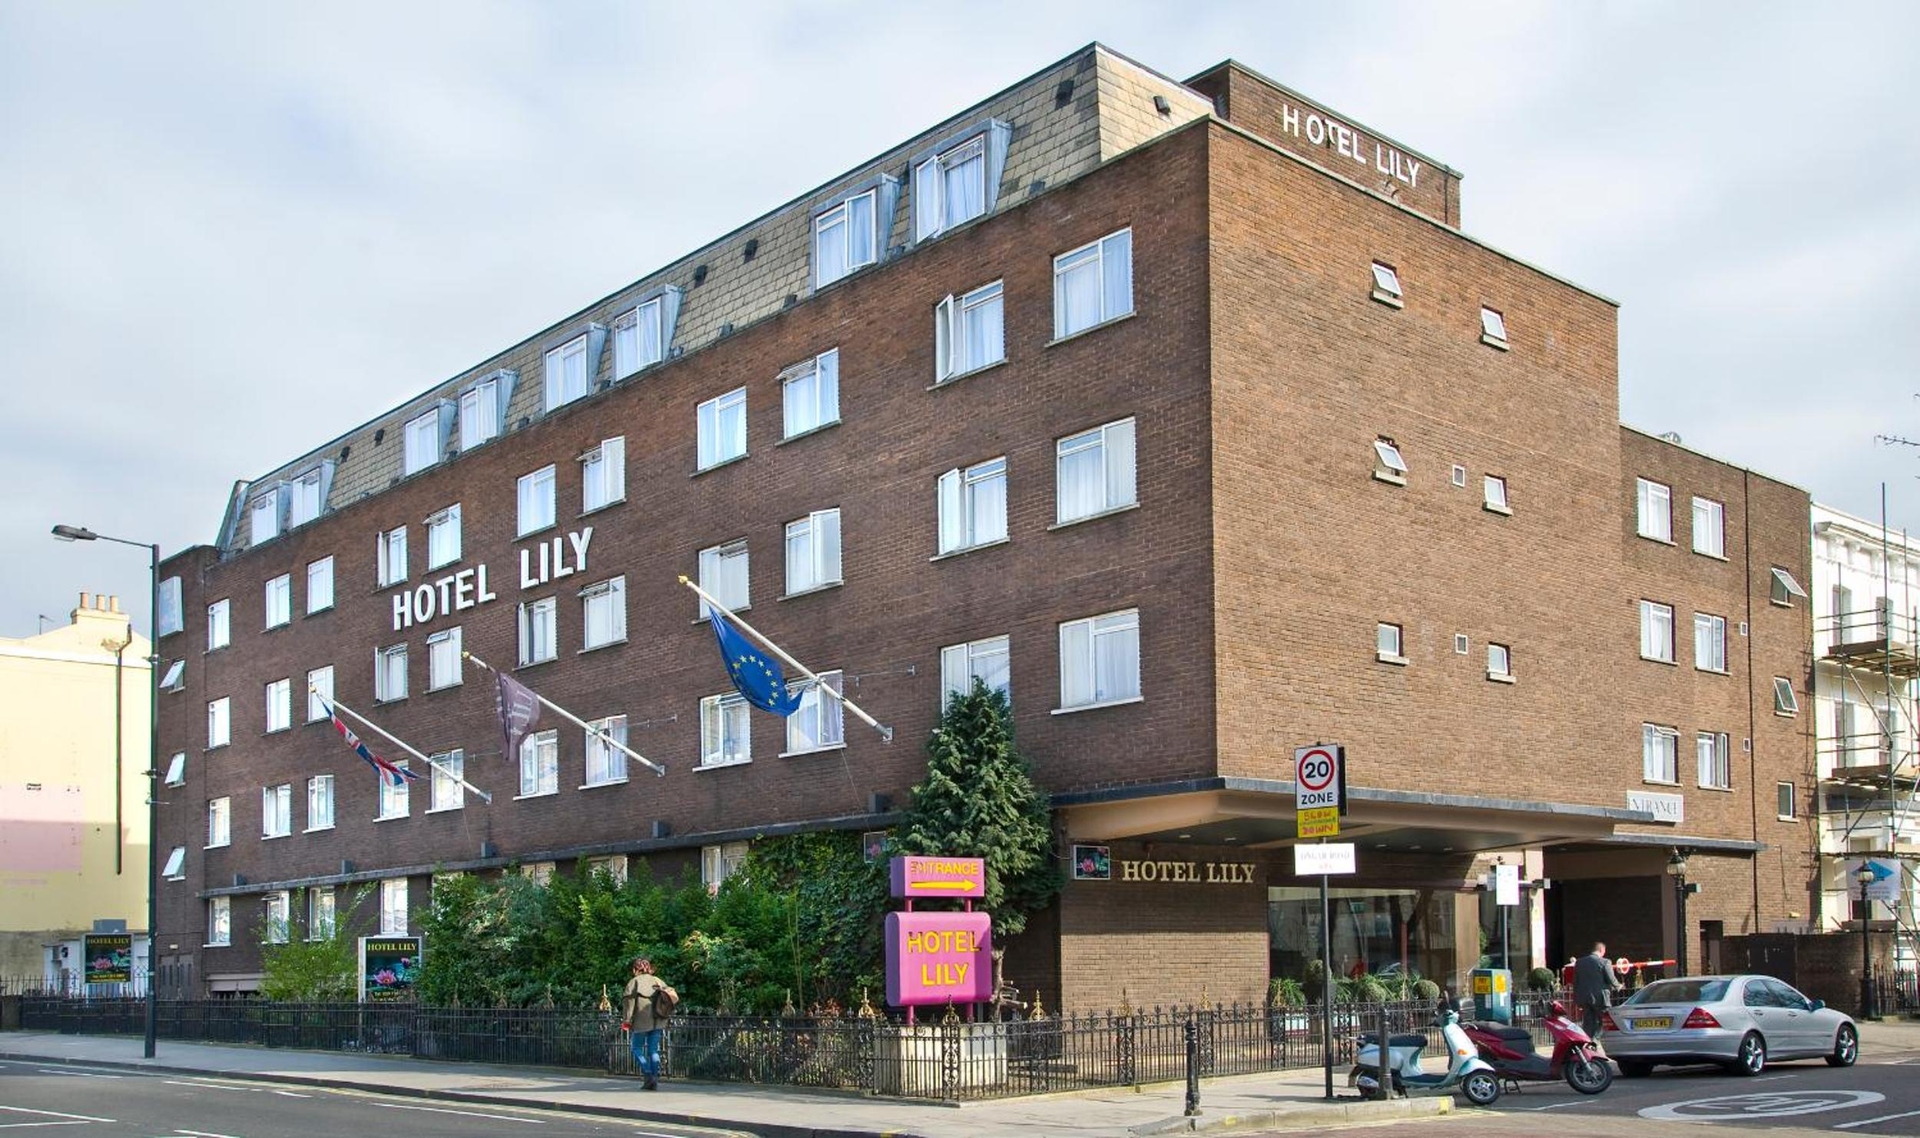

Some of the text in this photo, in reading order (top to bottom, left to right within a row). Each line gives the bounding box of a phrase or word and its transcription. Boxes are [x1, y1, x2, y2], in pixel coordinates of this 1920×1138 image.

[1283, 104, 1421, 188] HOTEL LILY
[393, 527, 594, 631] HOTEL LILY
[1305, 760, 1330, 779] 20
[1301, 792, 1334, 805] ZONE
[911, 861, 979, 875] ENTRANCE
[1121, 860, 1256, 884] HOTEL LILY
[87, 937, 130, 945] HOTEL LILY
[367, 943, 417, 951] HOTEL LILY
[907, 931, 982, 954] HOTEL
[921, 963, 969, 987] LILY
